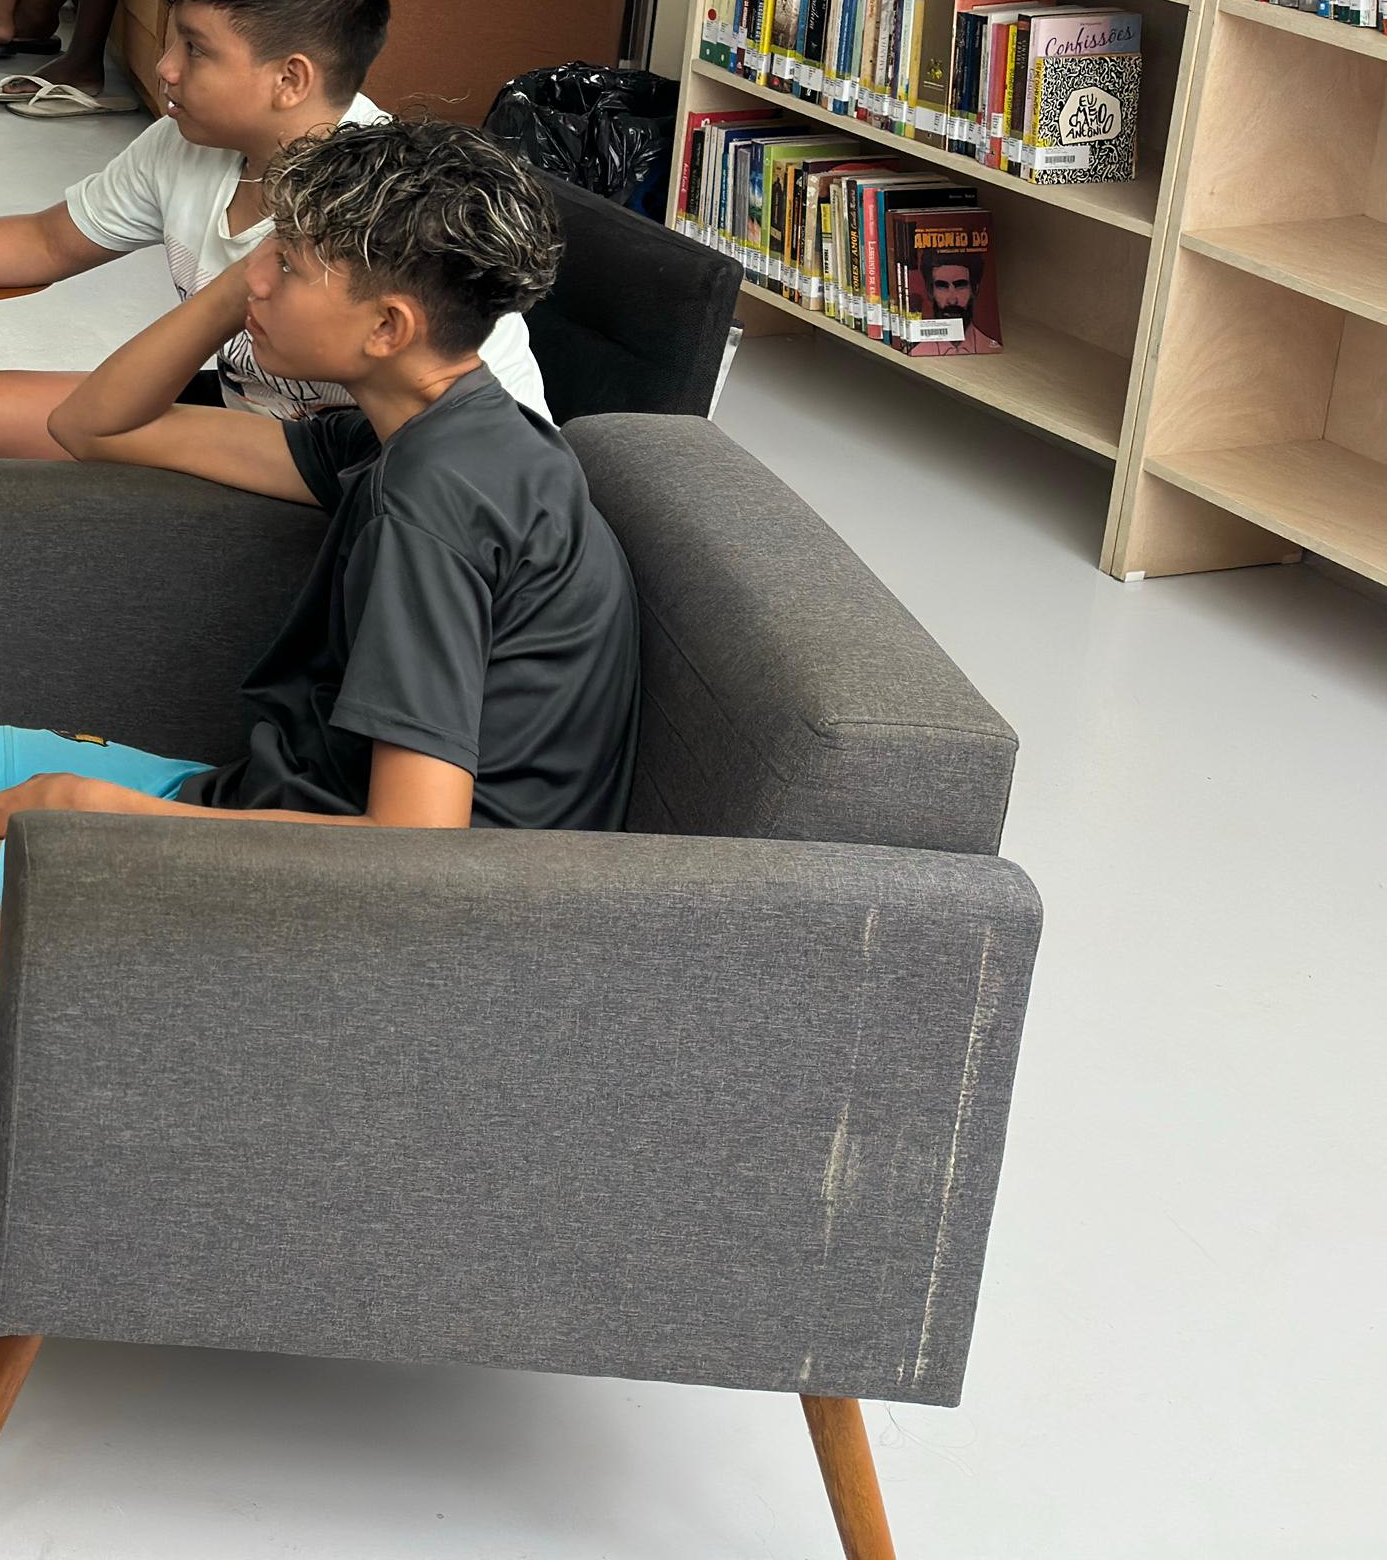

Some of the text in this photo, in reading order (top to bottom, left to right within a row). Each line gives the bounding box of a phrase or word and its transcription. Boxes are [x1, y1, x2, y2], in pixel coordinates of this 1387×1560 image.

[1045, 24, 1134, 56] Confissões
[1079, 94, 1097, 106] EU
[1077, 106, 1096, 116] ME
[850, 231, 859, 256] AMOR
[914, 227, 988, 248] ANTONIO DÓ
